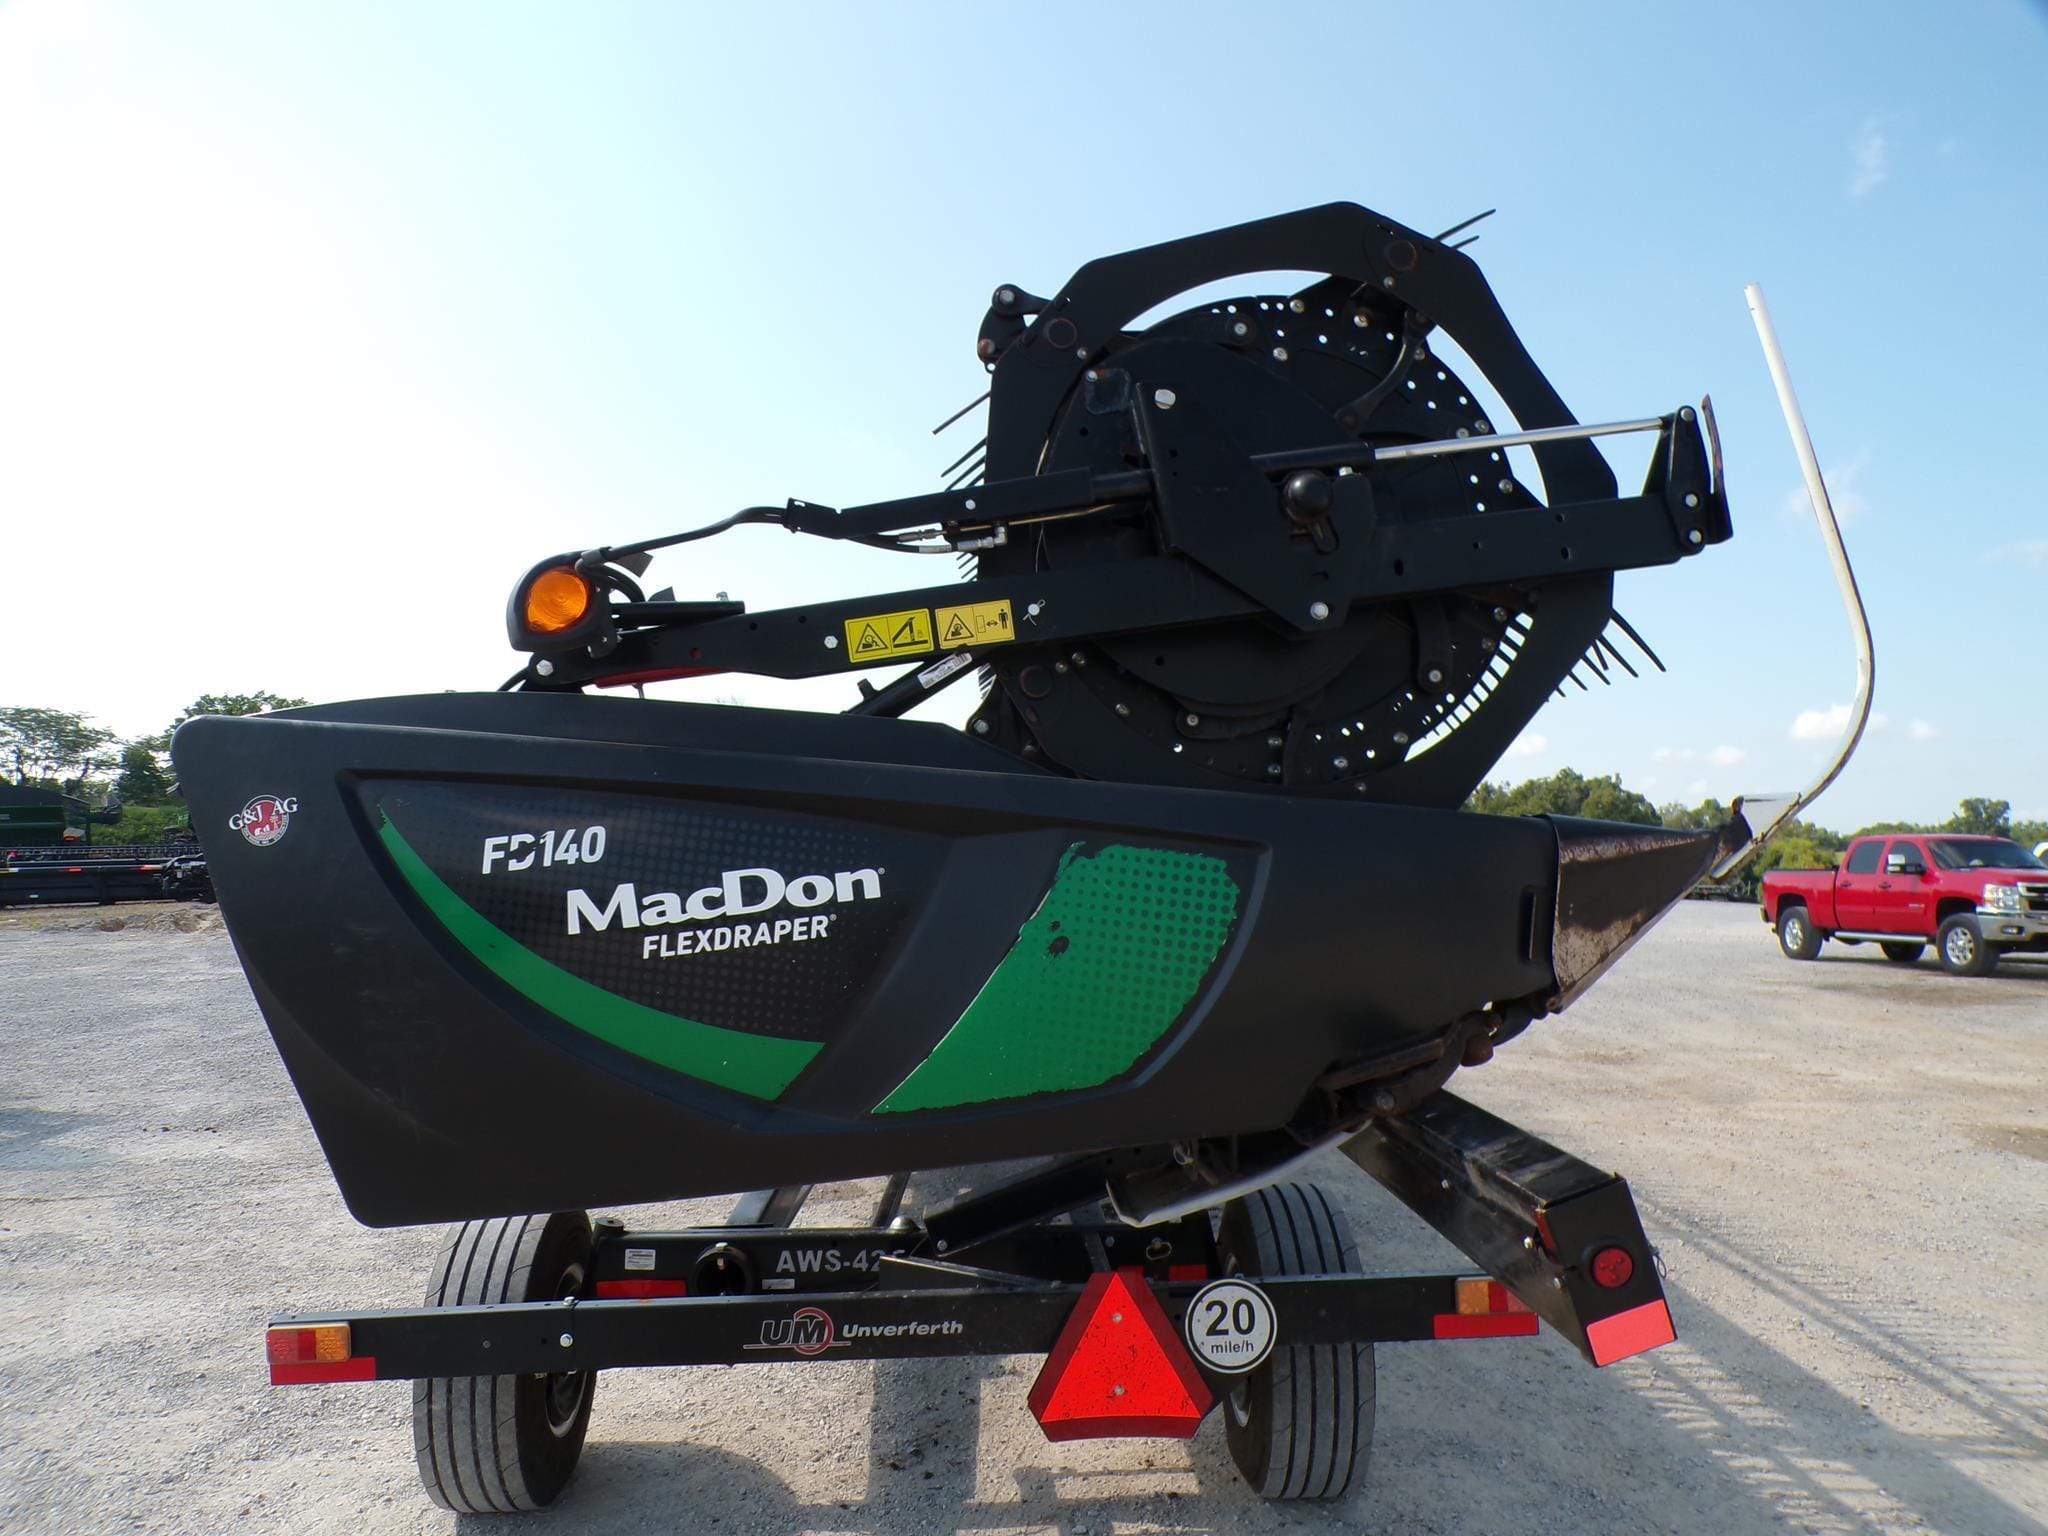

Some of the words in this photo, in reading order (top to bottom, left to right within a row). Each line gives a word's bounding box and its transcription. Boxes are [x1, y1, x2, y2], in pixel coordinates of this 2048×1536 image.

[229, 805, 263, 830] G&J
[272, 797, 298, 815] AG
[482, 825, 607, 875] FD140
[566, 867, 882, 935] MacDon
[642, 914, 830, 960] FLEXDRAPER
[842, 1321, 964, 1338] Unverferth
[1205, 1299, 1256, 1336] 20
[1211, 1341, 1254, 1354] mile/h
